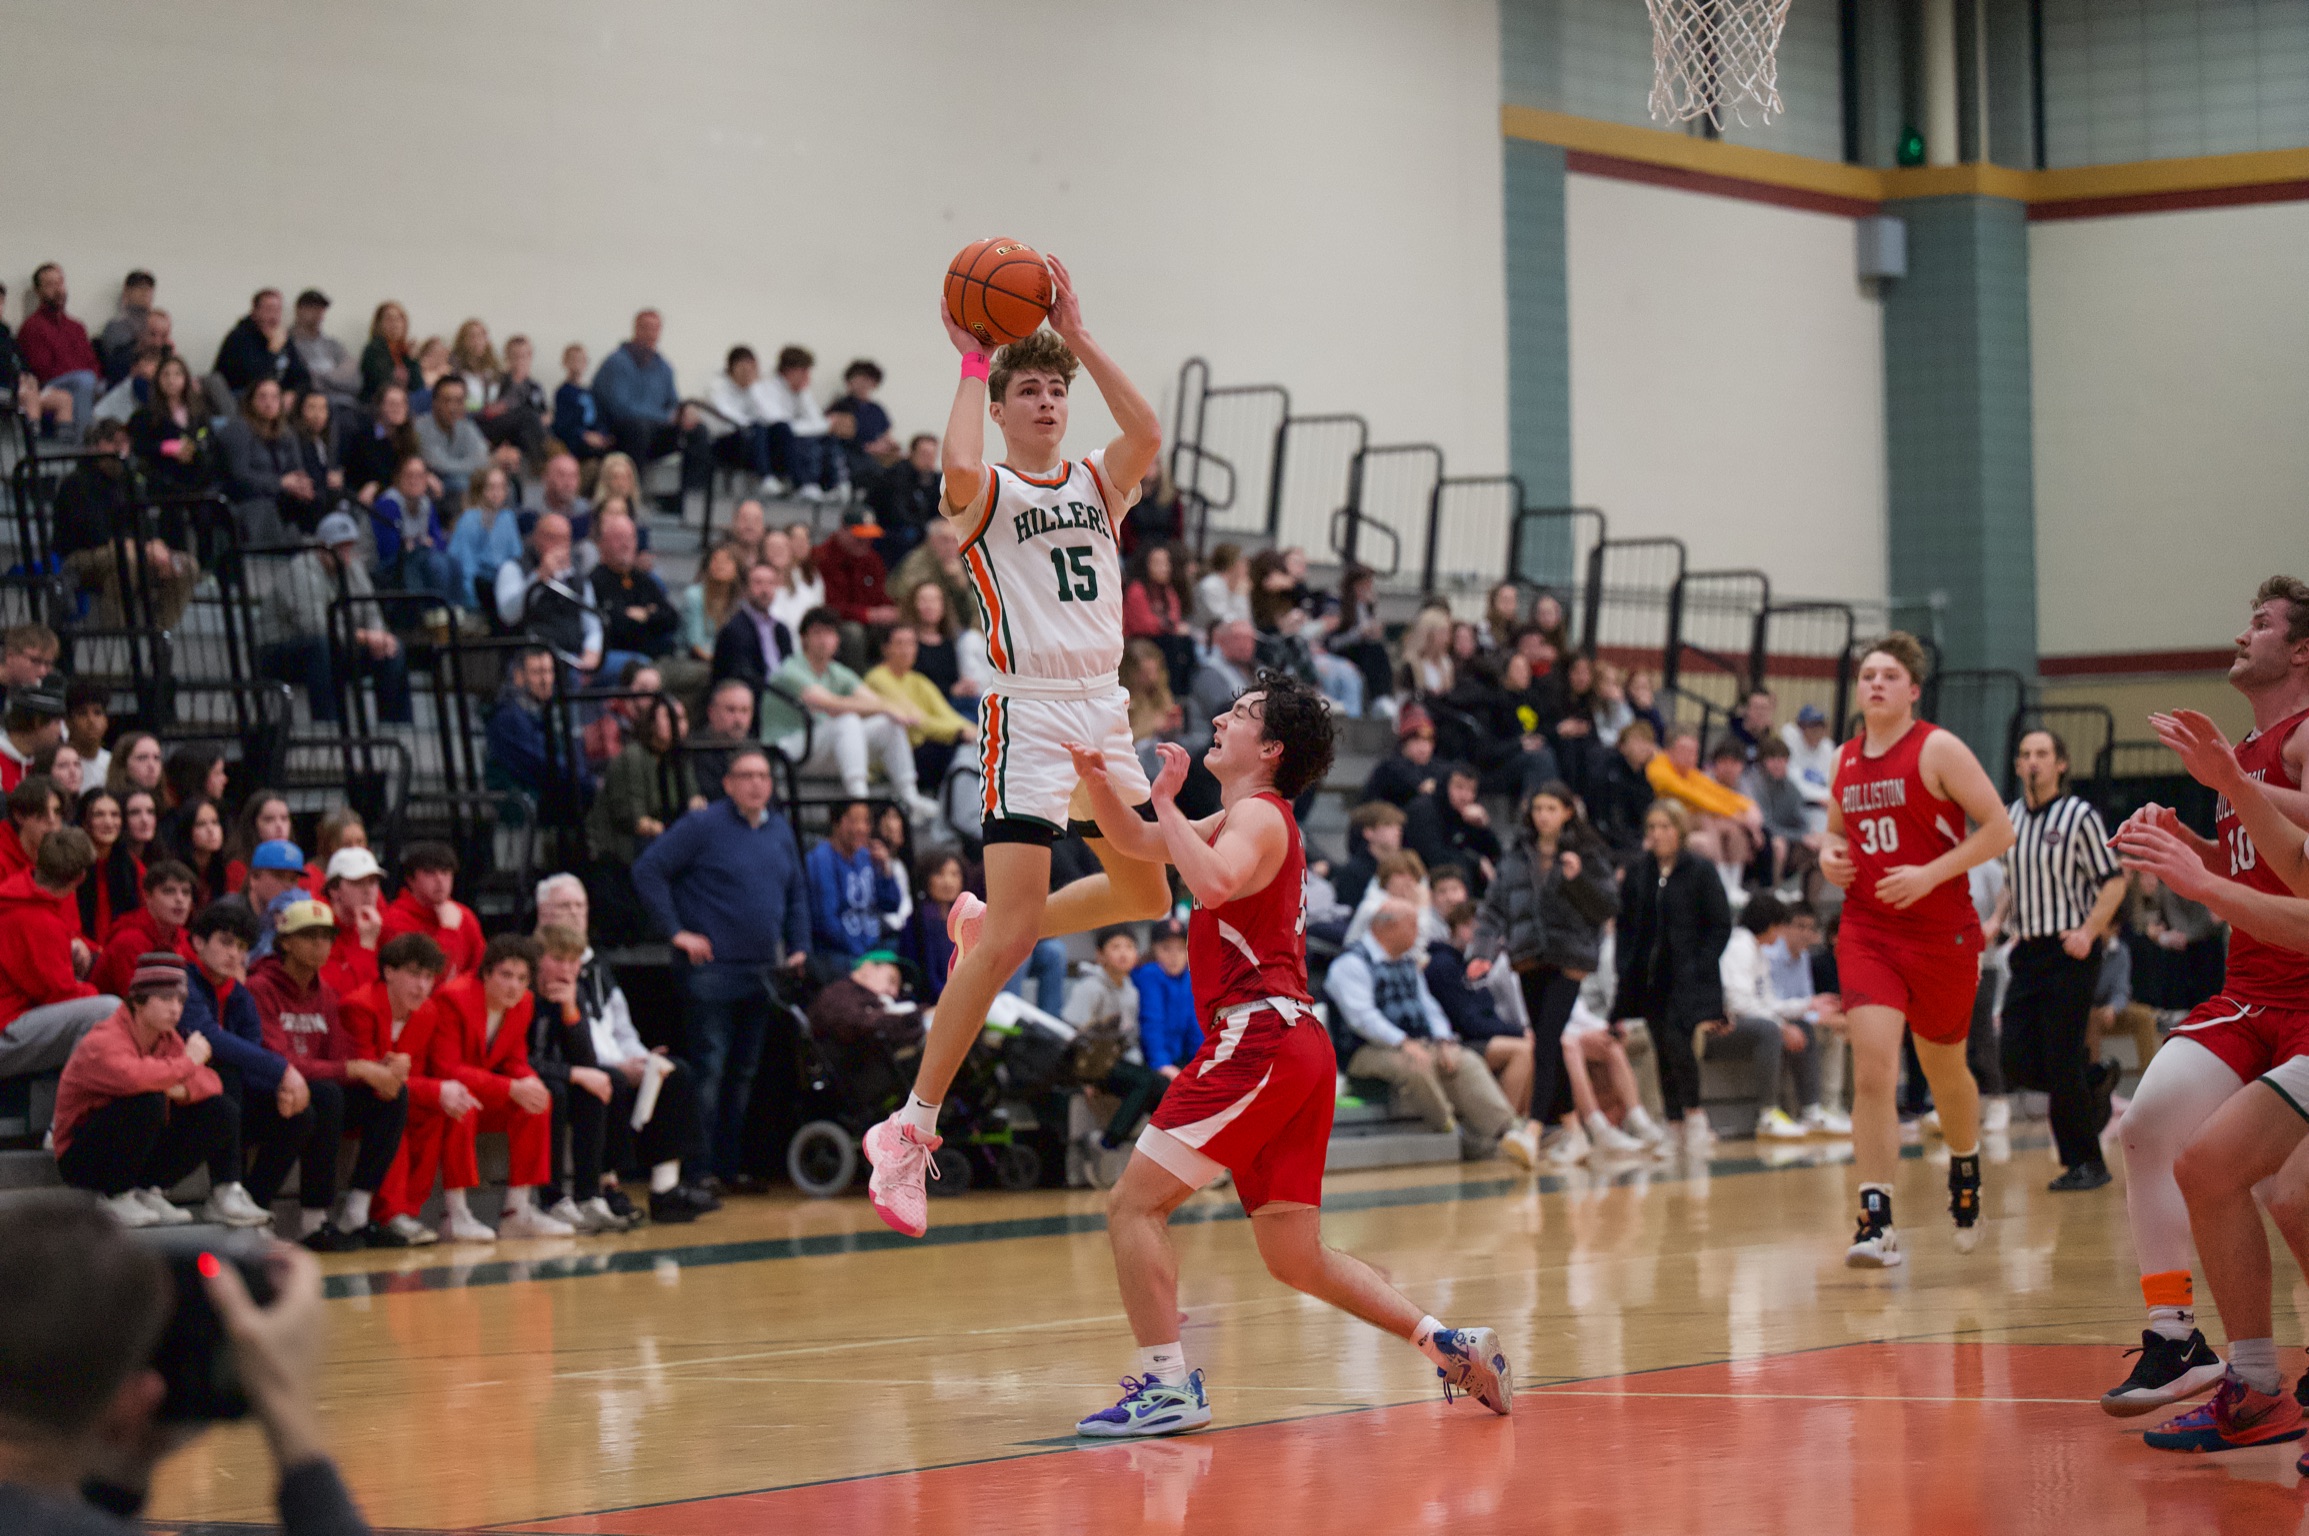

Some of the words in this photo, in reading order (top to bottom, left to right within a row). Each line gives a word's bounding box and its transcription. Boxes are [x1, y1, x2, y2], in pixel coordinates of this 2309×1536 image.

[1050, 545, 1099, 602] 15
[1842, 778, 1906, 813] HOLLISTON
[1858, 815, 1899, 855] 30
[2227, 825, 2256, 877] 10
